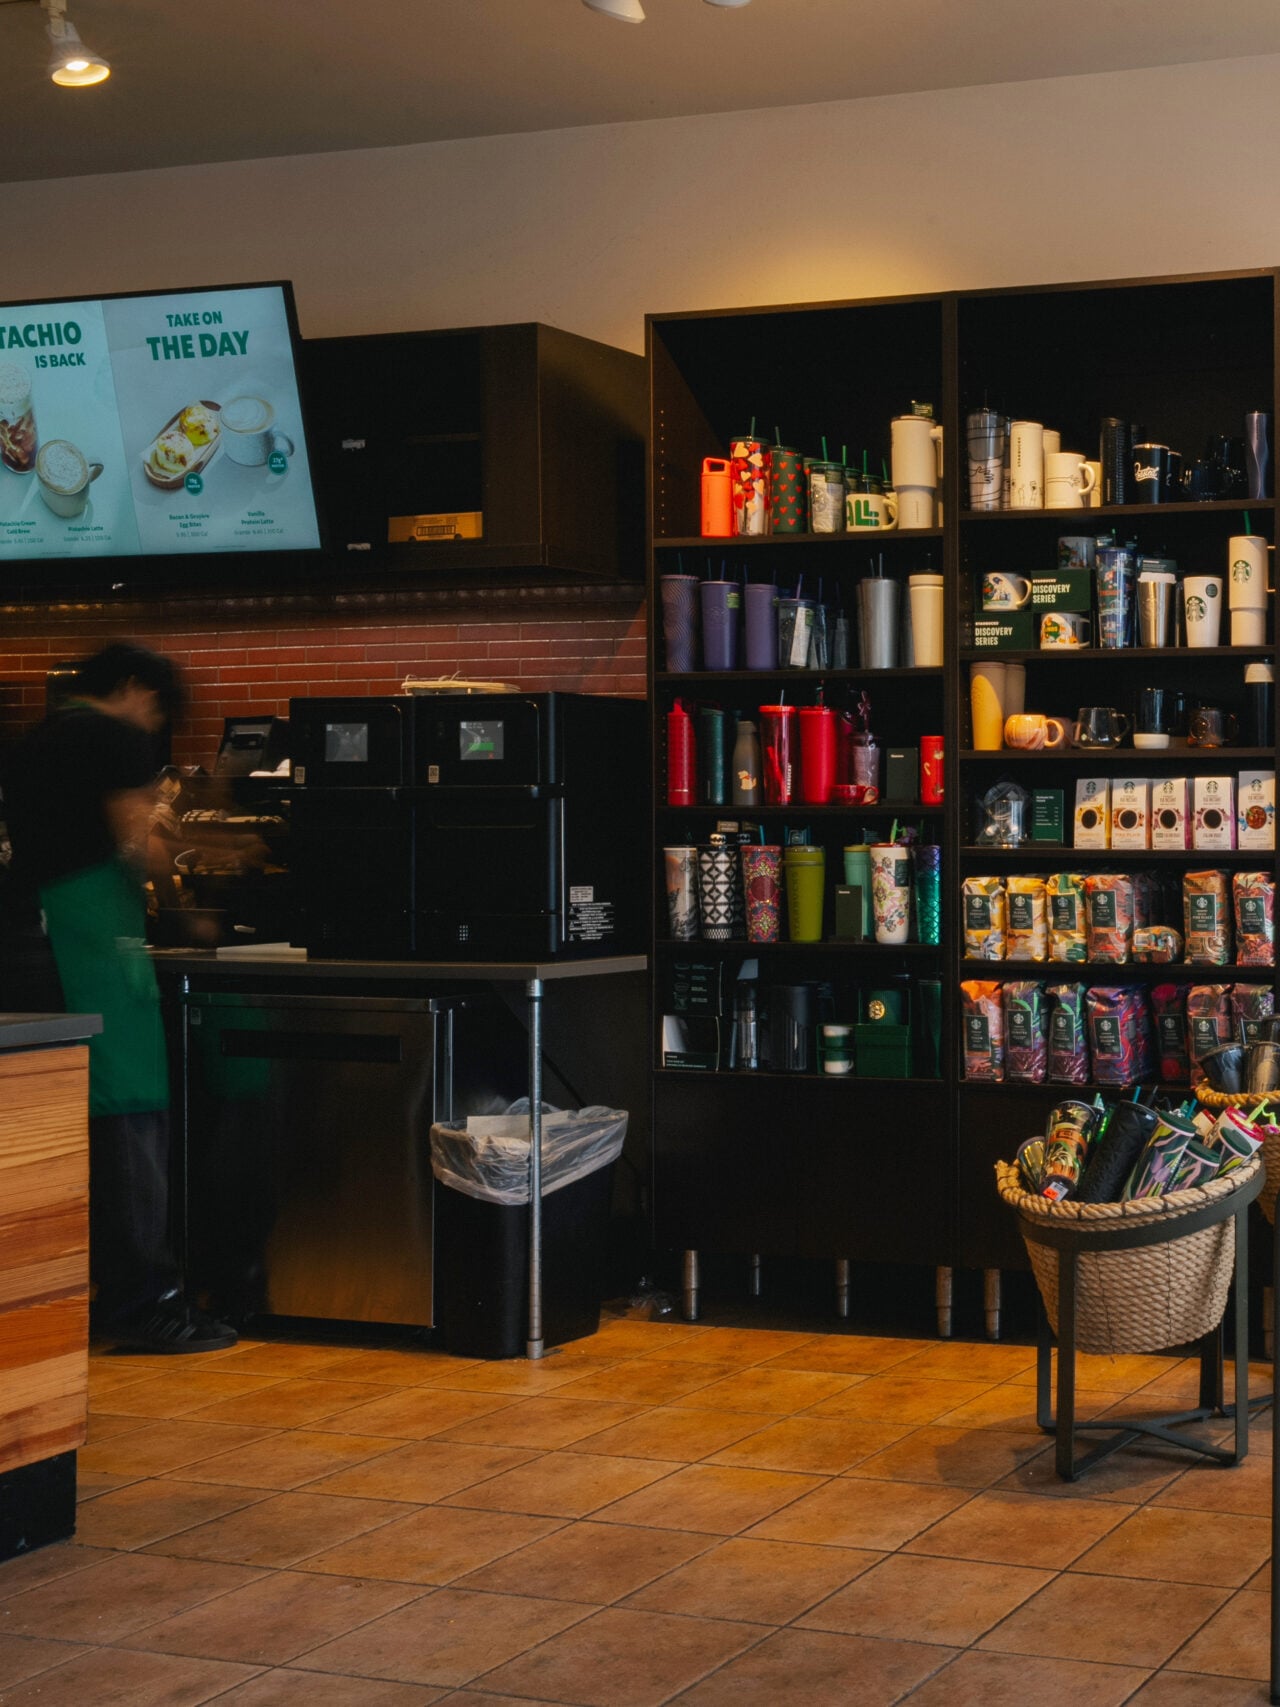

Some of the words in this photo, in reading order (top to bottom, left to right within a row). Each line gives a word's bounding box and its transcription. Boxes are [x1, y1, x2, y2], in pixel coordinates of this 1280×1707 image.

[166, 312, 200, 328] TAKE
[203, 310, 223, 325] ON
[146, 336, 196, 361] THE
[199, 330, 250, 359] DAY
[35, 355, 48, 369] IS
[50, 352, 86, 368] BACK
[1032, 584, 1071, 594] DISCOVERY
[1032, 594, 1056, 604] SERIES
[975, 627, 1013, 636] DISCOVERY
[975, 637, 999, 646] SERIES
